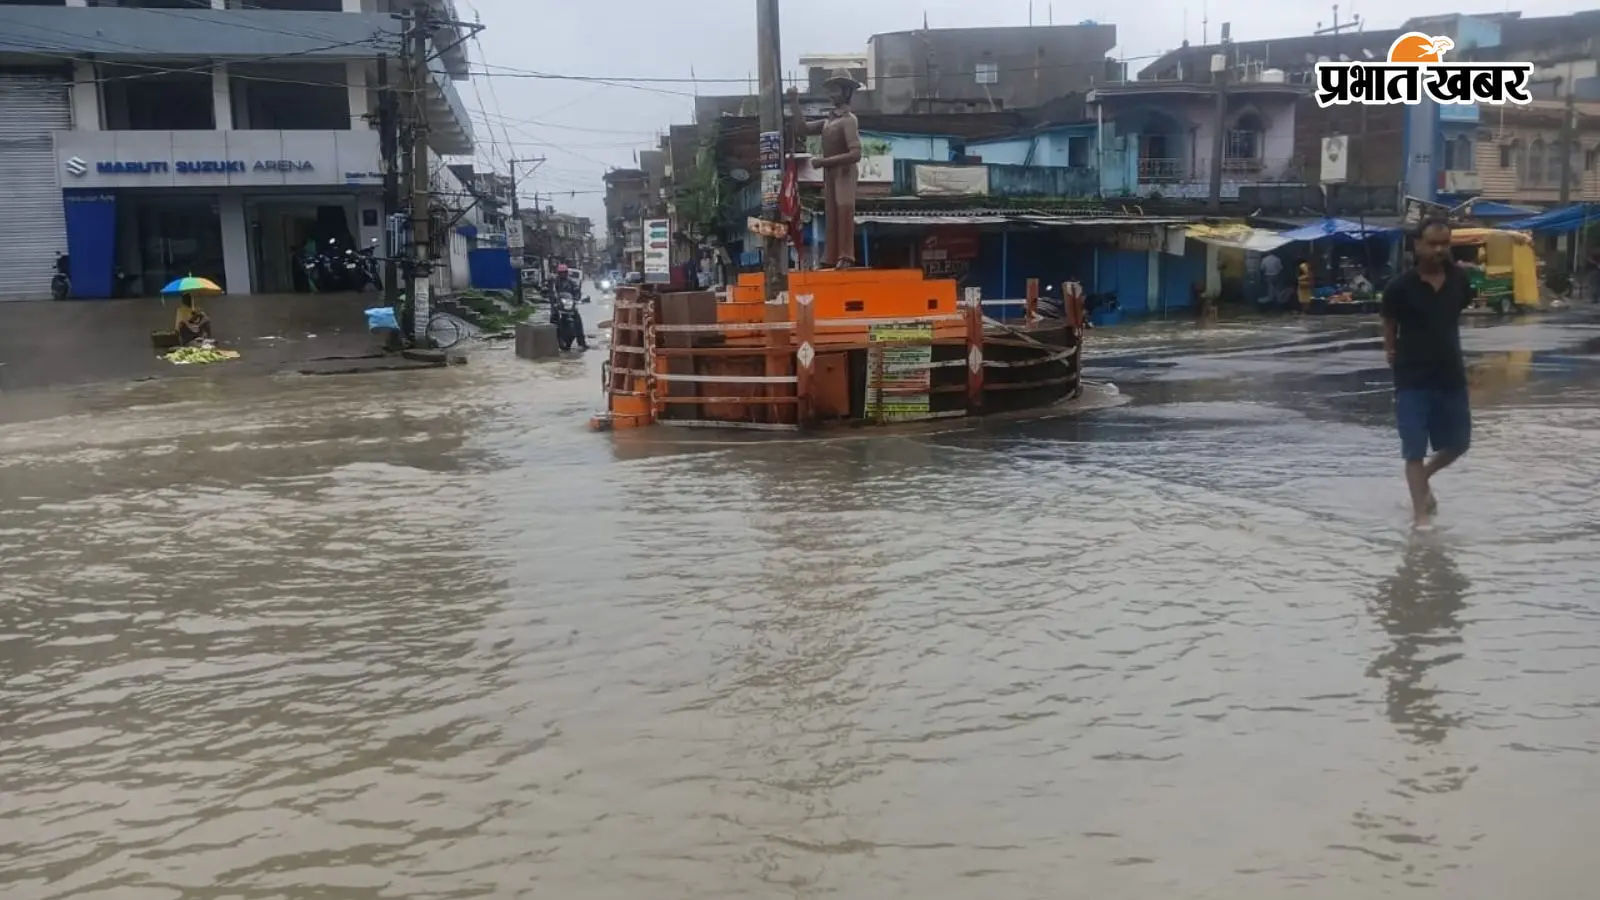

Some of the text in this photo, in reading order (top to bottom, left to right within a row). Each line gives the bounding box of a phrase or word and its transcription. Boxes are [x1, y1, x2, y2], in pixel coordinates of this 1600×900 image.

[96, 160, 315, 173] MARUTI SUZUKI ARENA
